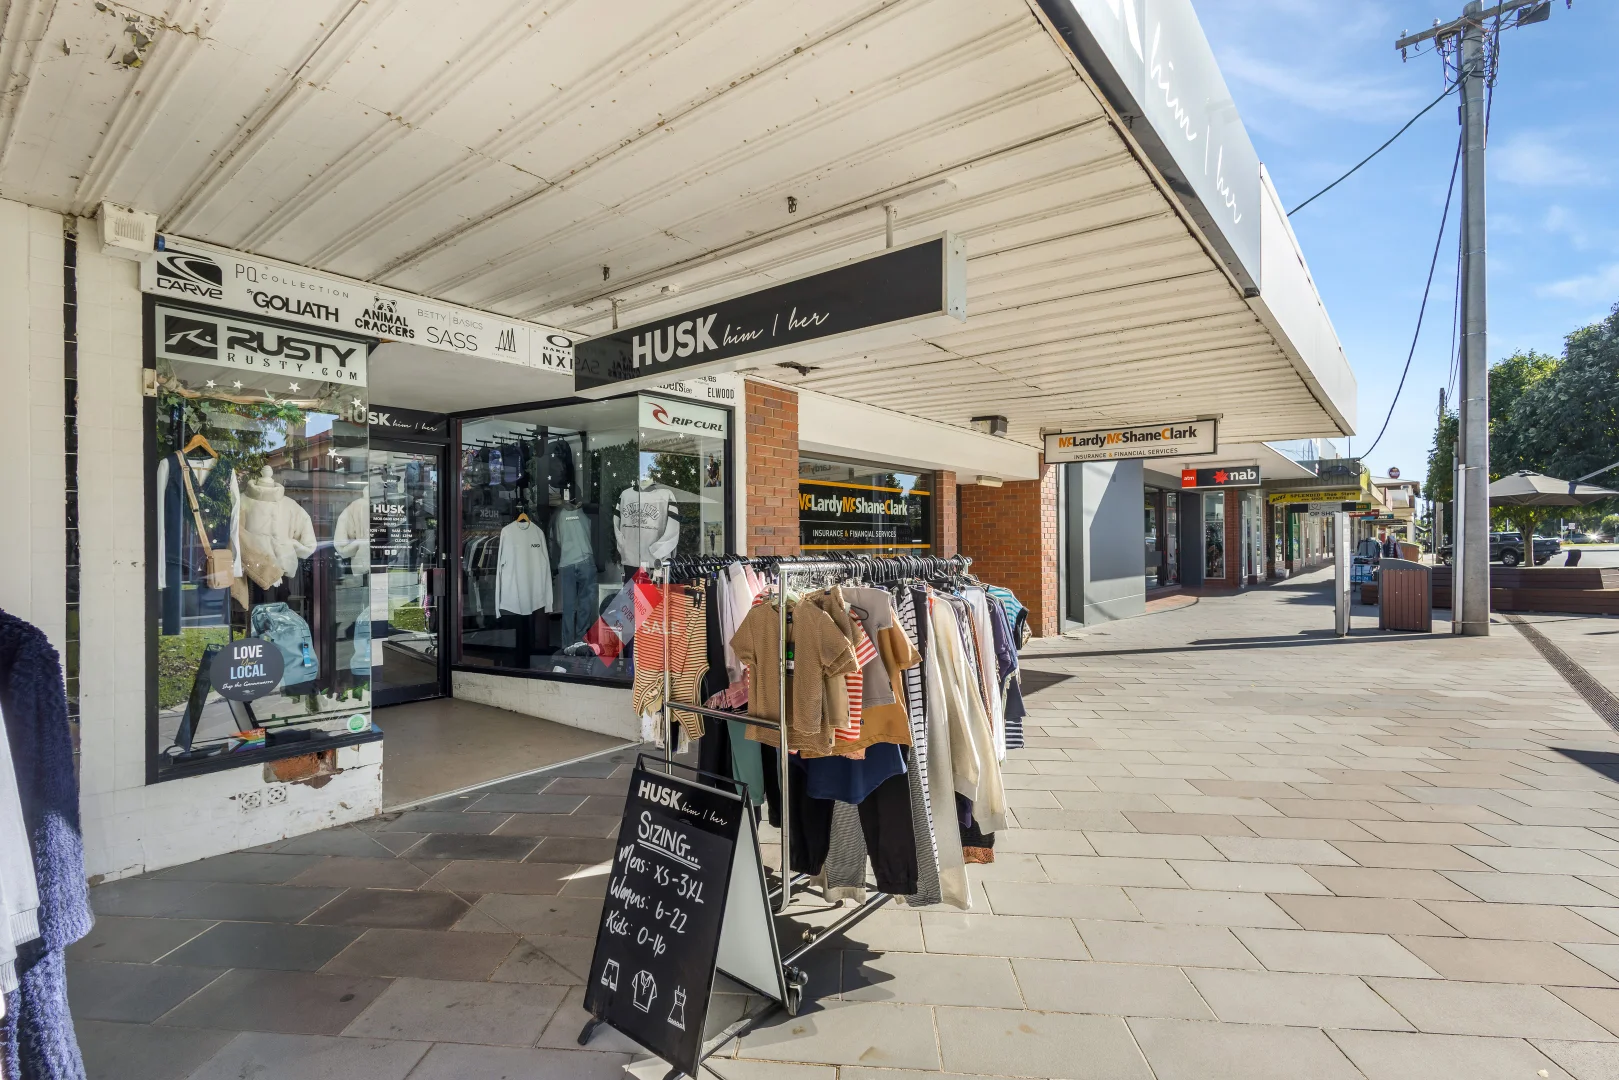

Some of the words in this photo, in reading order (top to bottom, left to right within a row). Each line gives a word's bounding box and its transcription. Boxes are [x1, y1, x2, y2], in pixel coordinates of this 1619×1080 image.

[235, 263, 259, 284] PQ
[261, 273, 349, 299] COLLECTION
[253, 291, 339, 323] GOLIATH
[362, 308, 408, 327] ANIMAL
[354, 317, 415, 339] CRACKERS
[417, 308, 447, 322] BETTY
[453, 316, 484, 330] BASICS
[226, 326, 357, 368] RUSTY
[426, 326, 478, 352] SASS
[632, 313, 719, 369] HUSK
[723, 325, 765, 347] him
[788, 307, 830, 330] her
[543, 346, 572, 356] OAKLE
[227, 352, 358, 381] RUSTY.COM
[707, 387, 735, 399] ELWOOD
[339, 405, 391, 427] HUSK
[671, 416, 693, 426] RIP
[693, 421, 724, 432] CURL
[1073, 452, 1107, 460] INSURANCE
[1114, 450, 1146, 458] FINANCIAL
[1230, 469, 1257, 480] nab
[373, 504, 405, 514] HUSK
[812, 529, 844, 537] INSURANCE
[850, 530, 875, 538] FINANCIAL
[876, 530, 897, 538] SERVICES
[626, 587, 647, 615] NOTHING
[621, 605, 635, 622] OVER
[233, 645, 263, 660] LOVE
[230, 663, 266, 680] LOCAL
[637, 780, 683, 811] HUSK
[681, 802, 700, 817] him
[710, 812, 728, 826] her
[619, 844, 651, 873] Mens:
[610, 876, 650, 910] Womens:
[655, 900, 687, 934] 6-22
[605, 910, 633, 937] Kids:
[637, 926, 666, 958] 0-16
